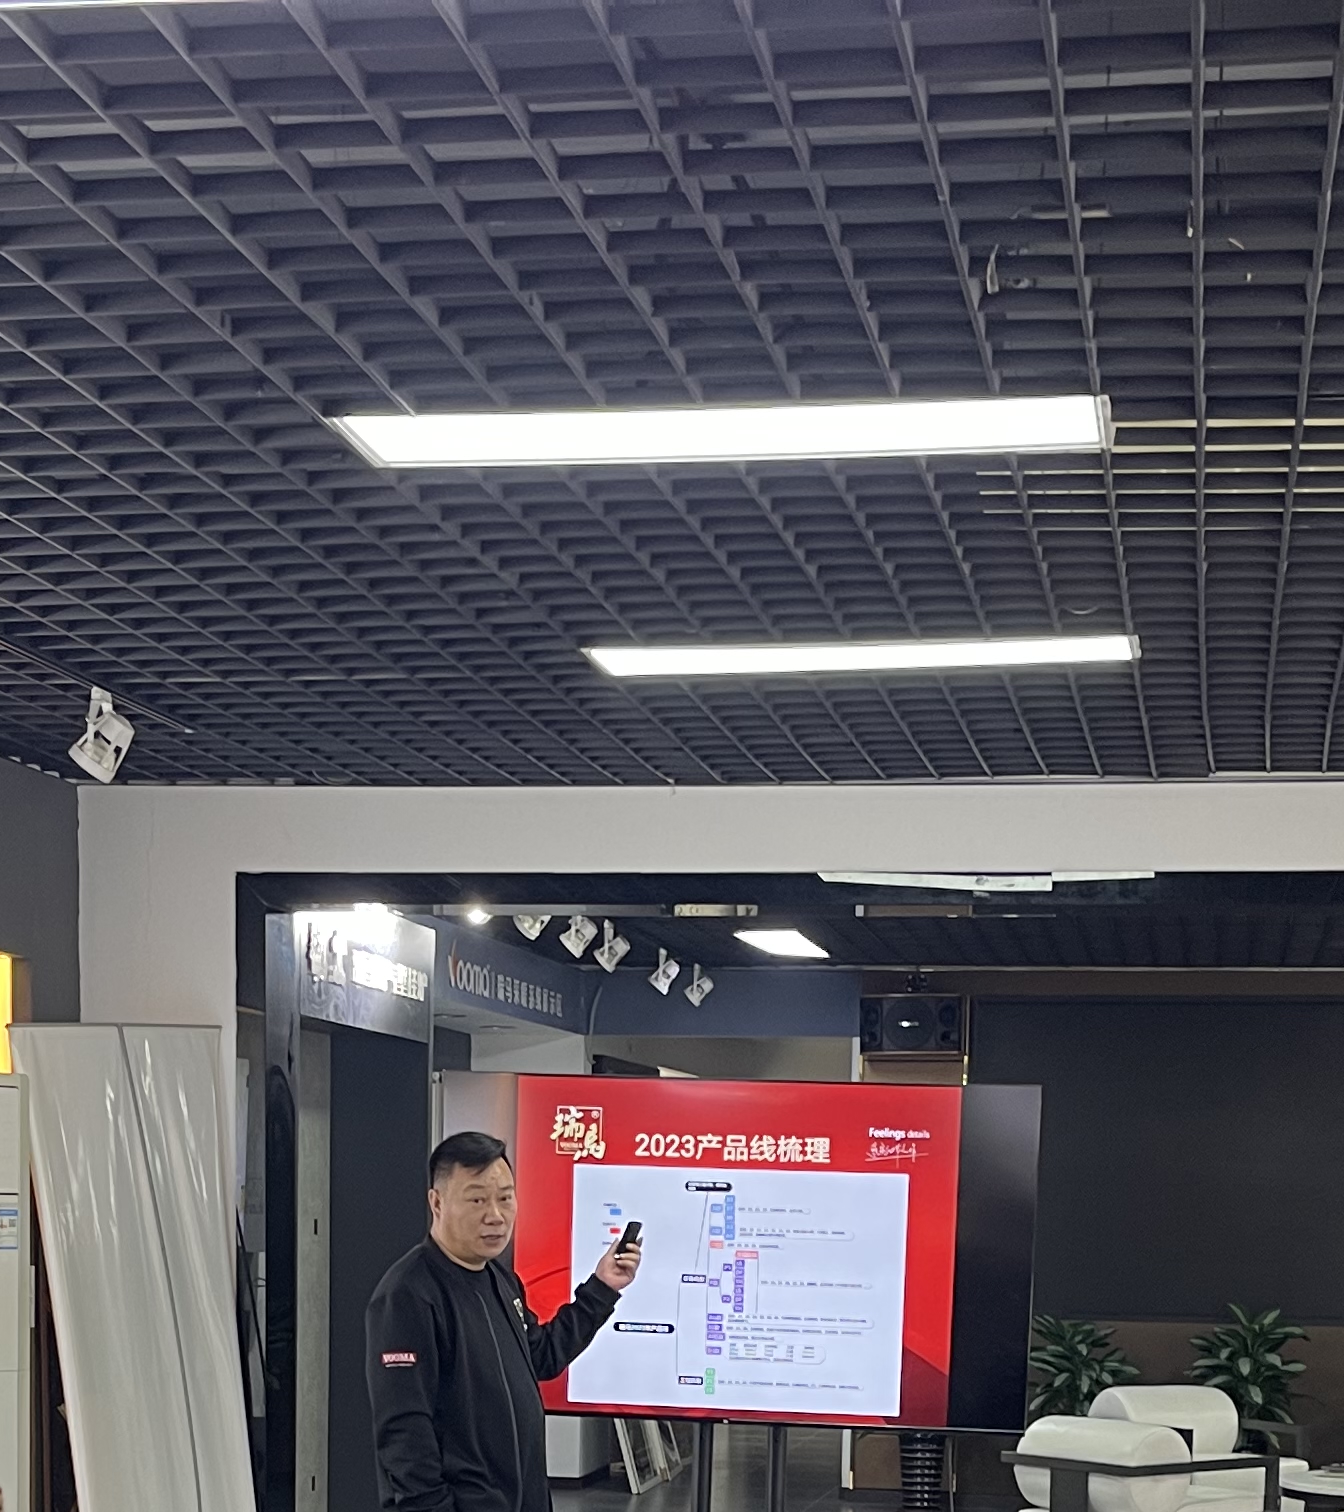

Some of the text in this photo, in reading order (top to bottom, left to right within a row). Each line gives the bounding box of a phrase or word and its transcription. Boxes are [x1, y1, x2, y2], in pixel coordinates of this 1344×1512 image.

[869, 1127, 906, 1141] Feelings
[634, 1132, 831, 1163] 2023产品线梳理
